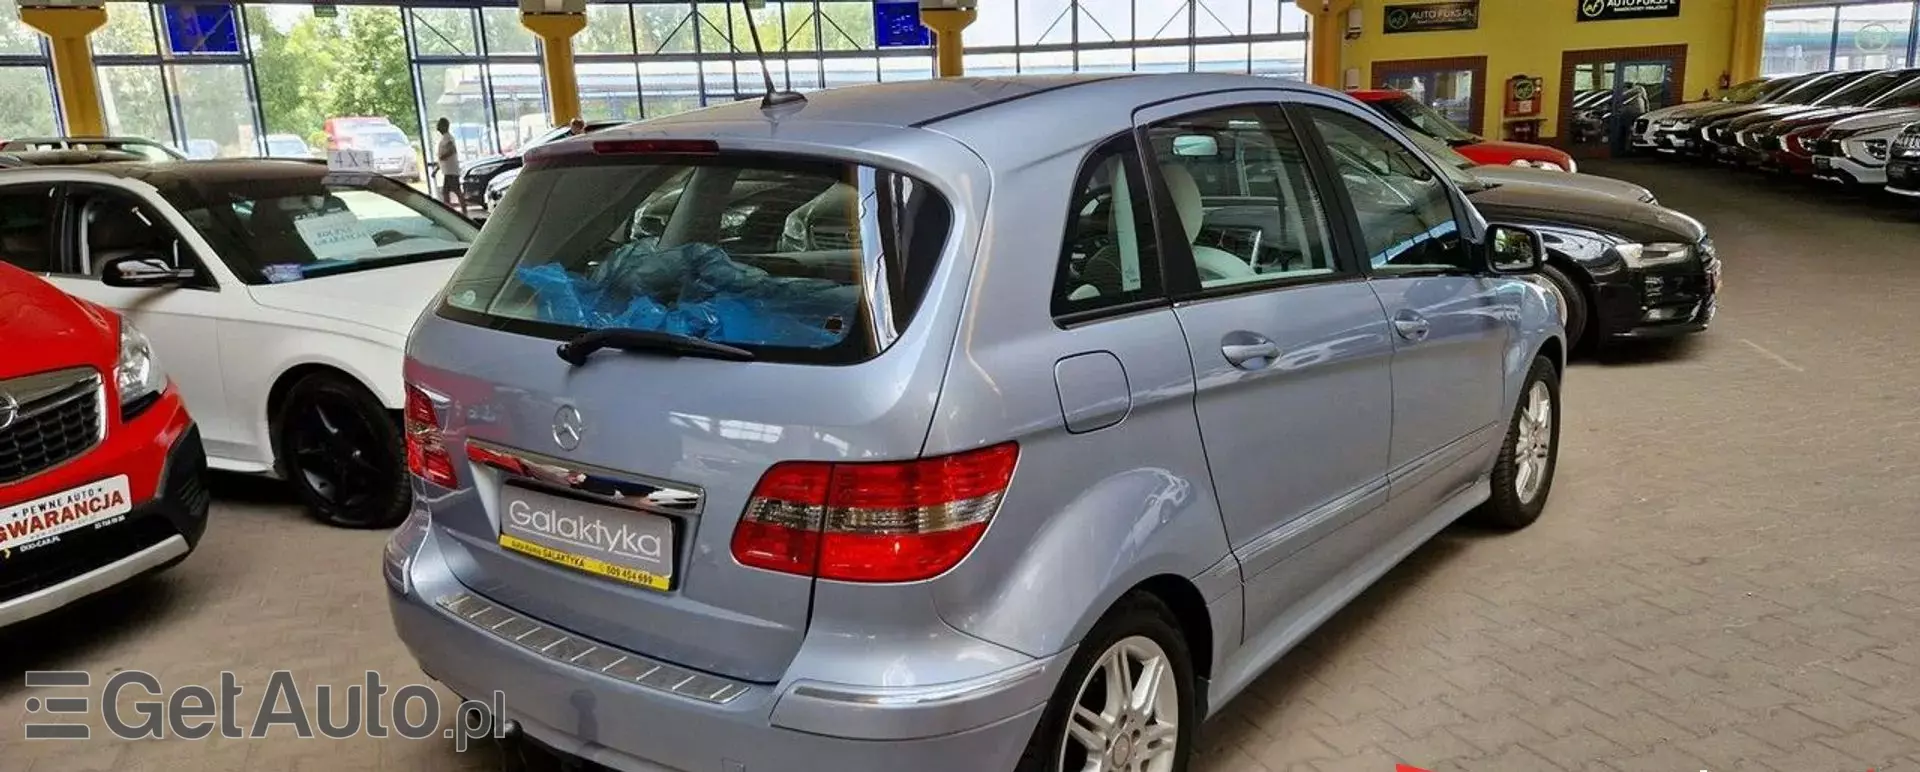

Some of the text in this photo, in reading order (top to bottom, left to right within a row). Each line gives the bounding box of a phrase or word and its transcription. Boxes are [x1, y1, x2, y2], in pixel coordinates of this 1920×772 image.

[1410, 10, 1437, 20] AUTO
[22, 488, 95, 517] PEWNE AUTO
[509, 500, 661, 557] Galaktyka
[543, 547, 585, 567] GALAKTYKA
